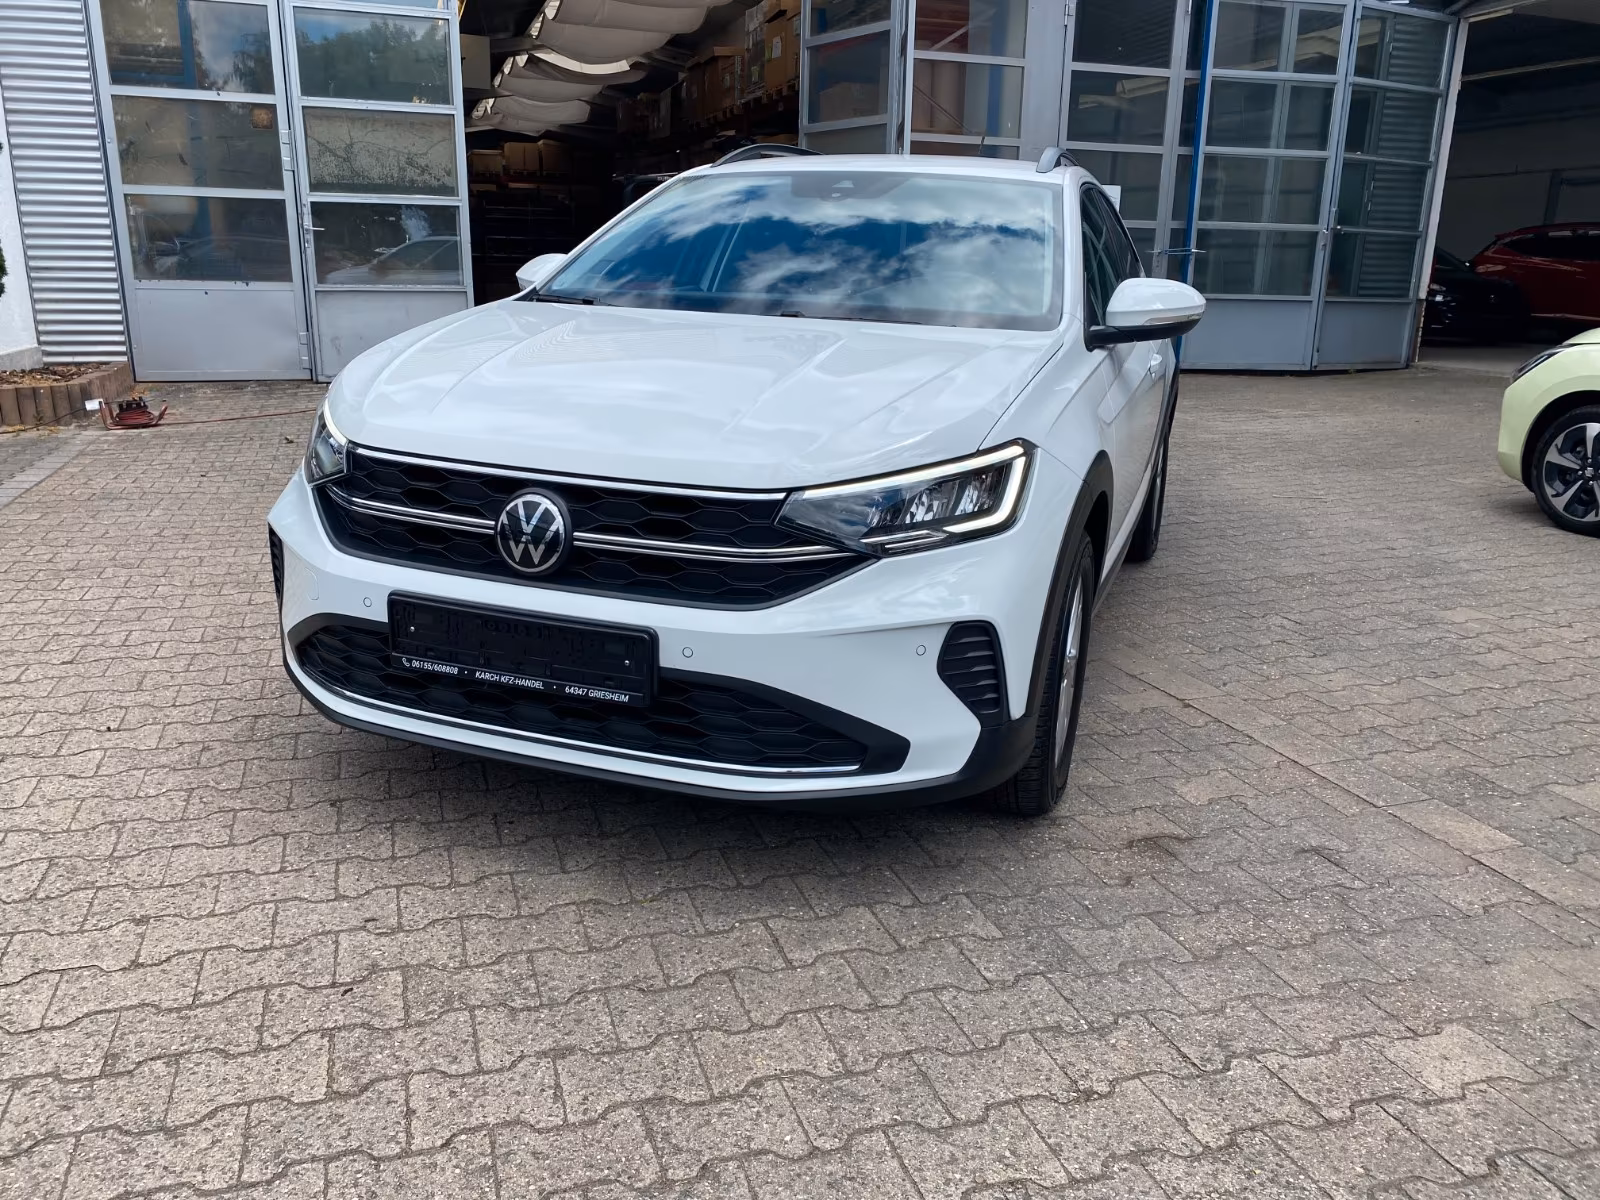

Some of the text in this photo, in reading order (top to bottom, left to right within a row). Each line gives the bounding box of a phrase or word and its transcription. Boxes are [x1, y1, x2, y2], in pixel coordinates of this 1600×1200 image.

[499, 496, 563, 570] VW
[411, 659, 630, 703] 06155/608808 KARCH KFZ-HANDEL 64347 GRIESHEIM
